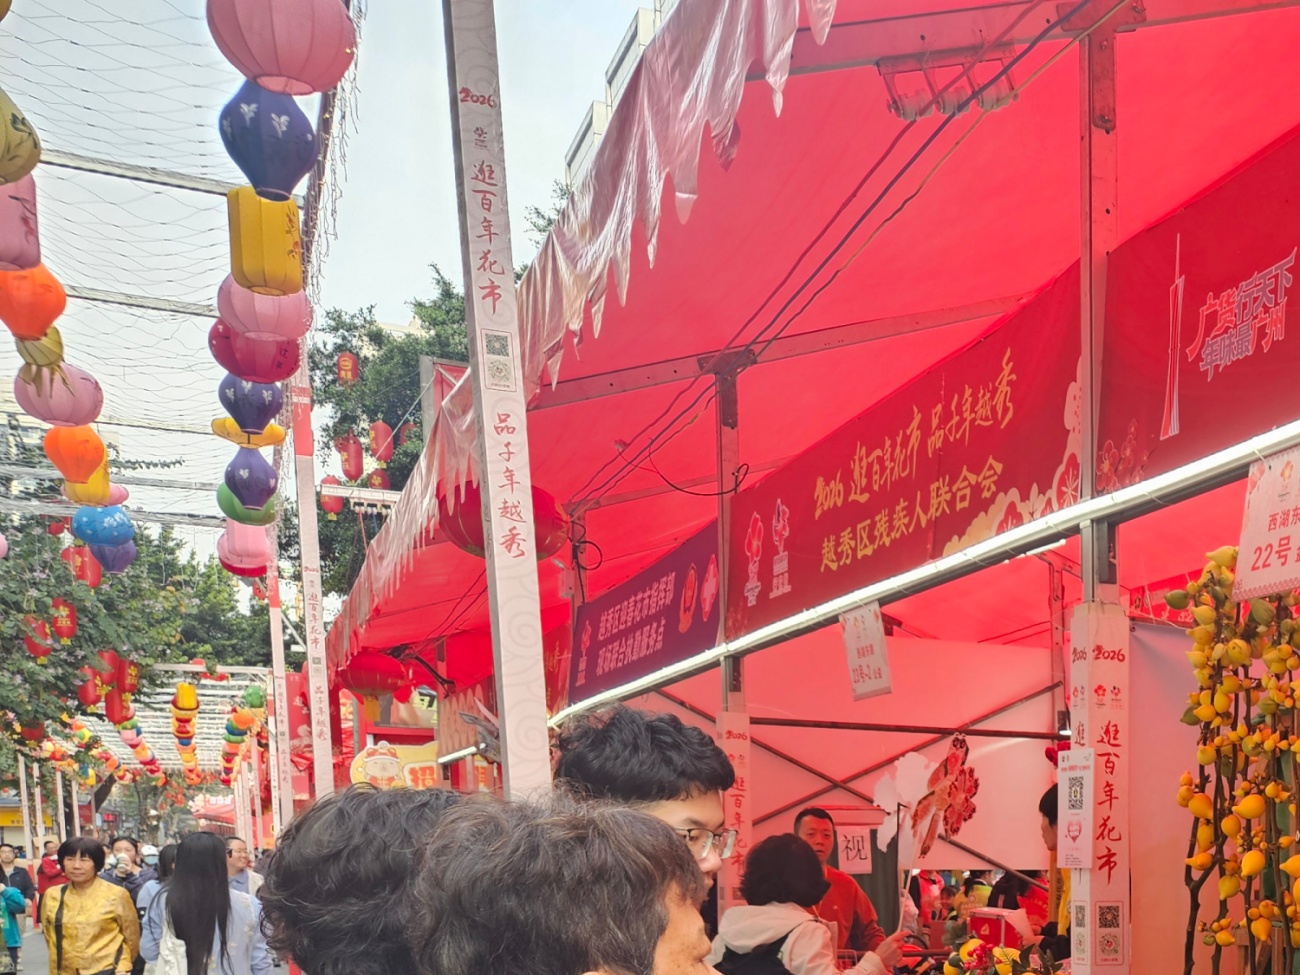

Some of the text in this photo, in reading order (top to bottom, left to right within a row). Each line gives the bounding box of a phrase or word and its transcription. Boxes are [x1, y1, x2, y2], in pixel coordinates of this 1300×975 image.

[459, 87, 497, 109] 2026
[470, 160, 505, 316] 逛百年花市
[1186, 247, 1297, 362] 广货行天下
[1199, 296, 1287, 382] 年味最广州
[814, 347, 1016, 520] 2026 逛百年花市 品千年越秀
[820, 455, 1003, 573] 越秀区残疾人联合会
[1251, 535, 1292, 572] 22号
[1093, 645, 1126, 663] 2026
[725, 730, 748, 741] 2026
[1096, 720, 1124, 886] 逛百年花市
